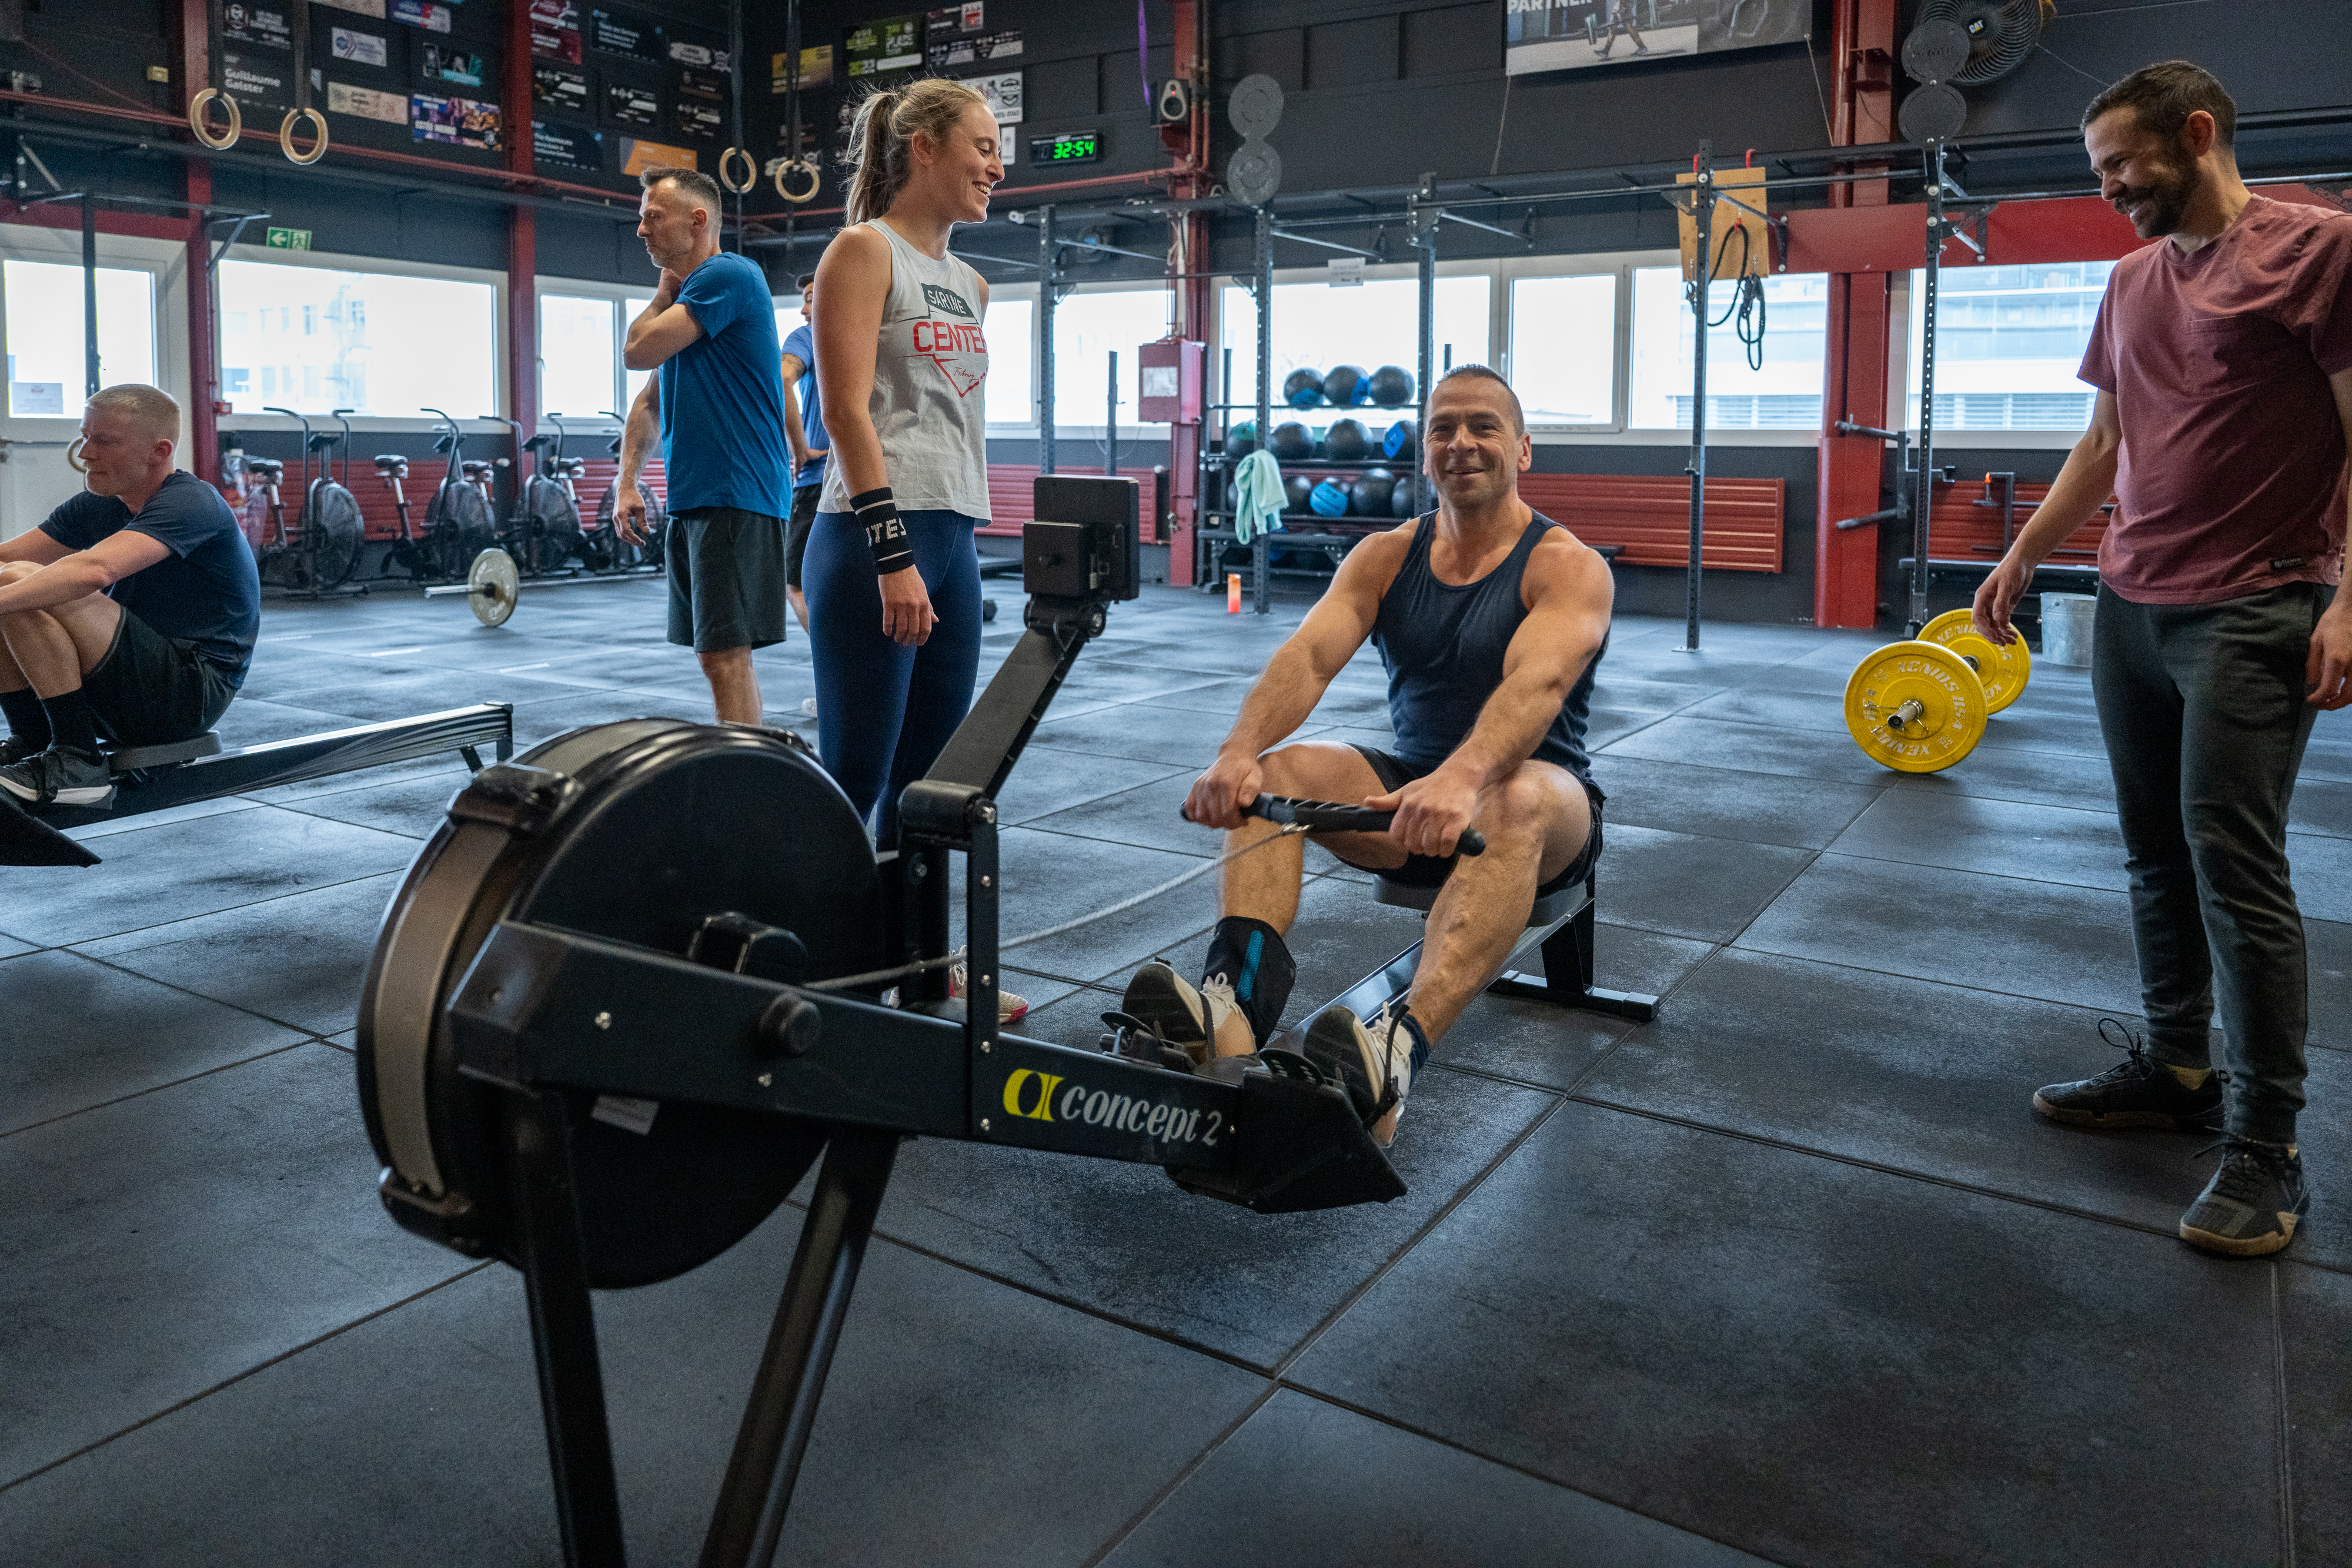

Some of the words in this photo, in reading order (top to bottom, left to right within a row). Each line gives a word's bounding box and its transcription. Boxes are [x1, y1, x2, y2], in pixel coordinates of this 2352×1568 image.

[1507, 0, 1592, 14] PART
[1969, 20, 1984, 34] CAT
[1053, 141, 1094, 159] 32:54
[927, 290, 967, 315] SARINE
[1937, 624, 1978, 645] XENIU
[1897, 661, 1960, 692] XENIUS
[1952, 696, 1966, 730] USA
[1060, 1085, 1201, 1143] concept
[1201, 1110, 1223, 1146] 2
